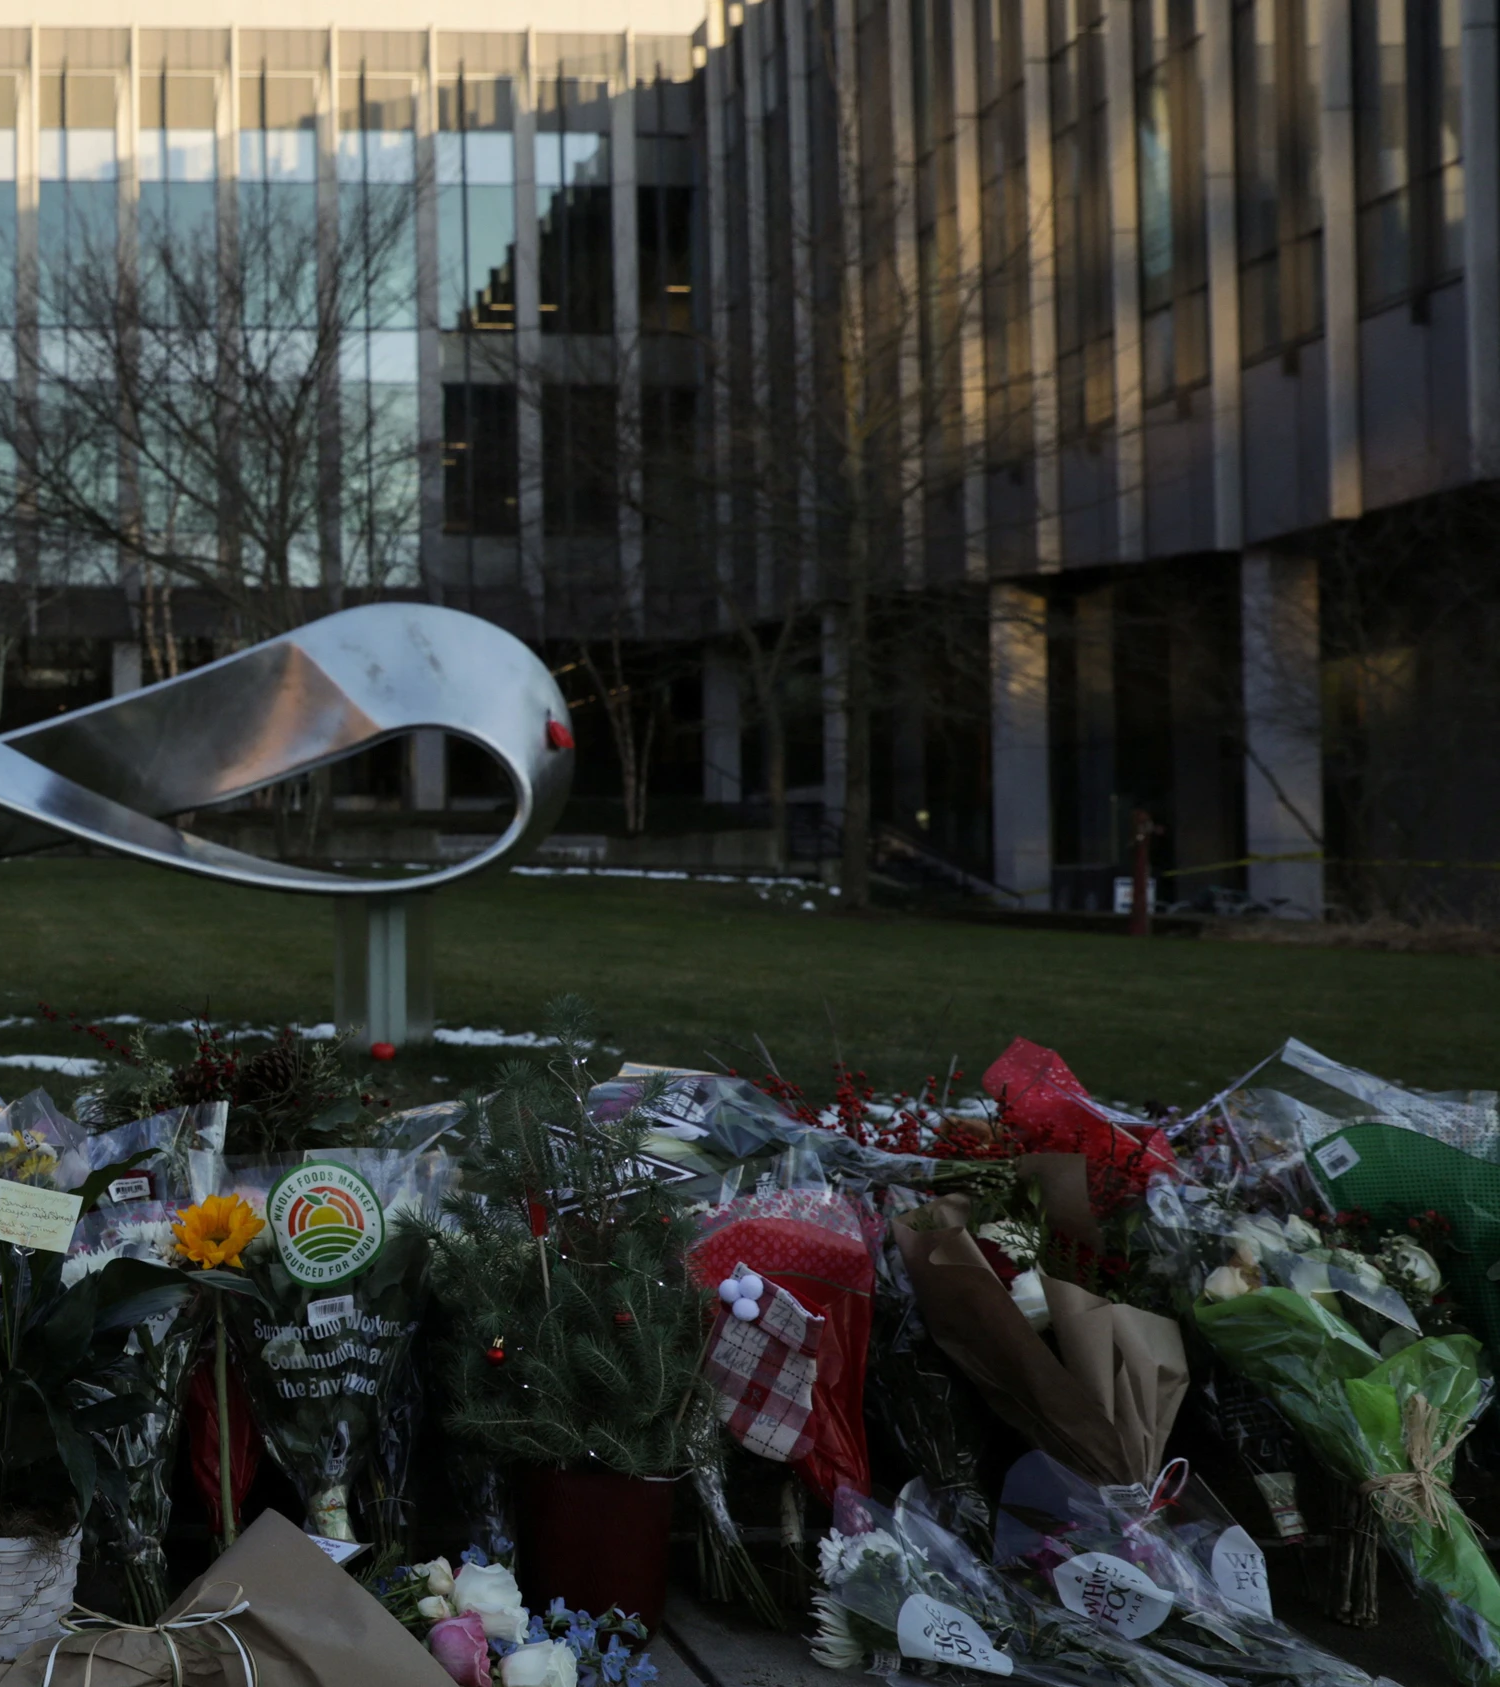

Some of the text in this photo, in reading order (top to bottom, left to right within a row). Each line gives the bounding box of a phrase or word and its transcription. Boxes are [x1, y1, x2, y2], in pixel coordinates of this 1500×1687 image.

[274, 1171, 375, 1221] WHOLE FOODS MARKET
[282, 1235, 376, 1278] SOURCED FOR GOOD
[276, 1377, 306, 1399] the
